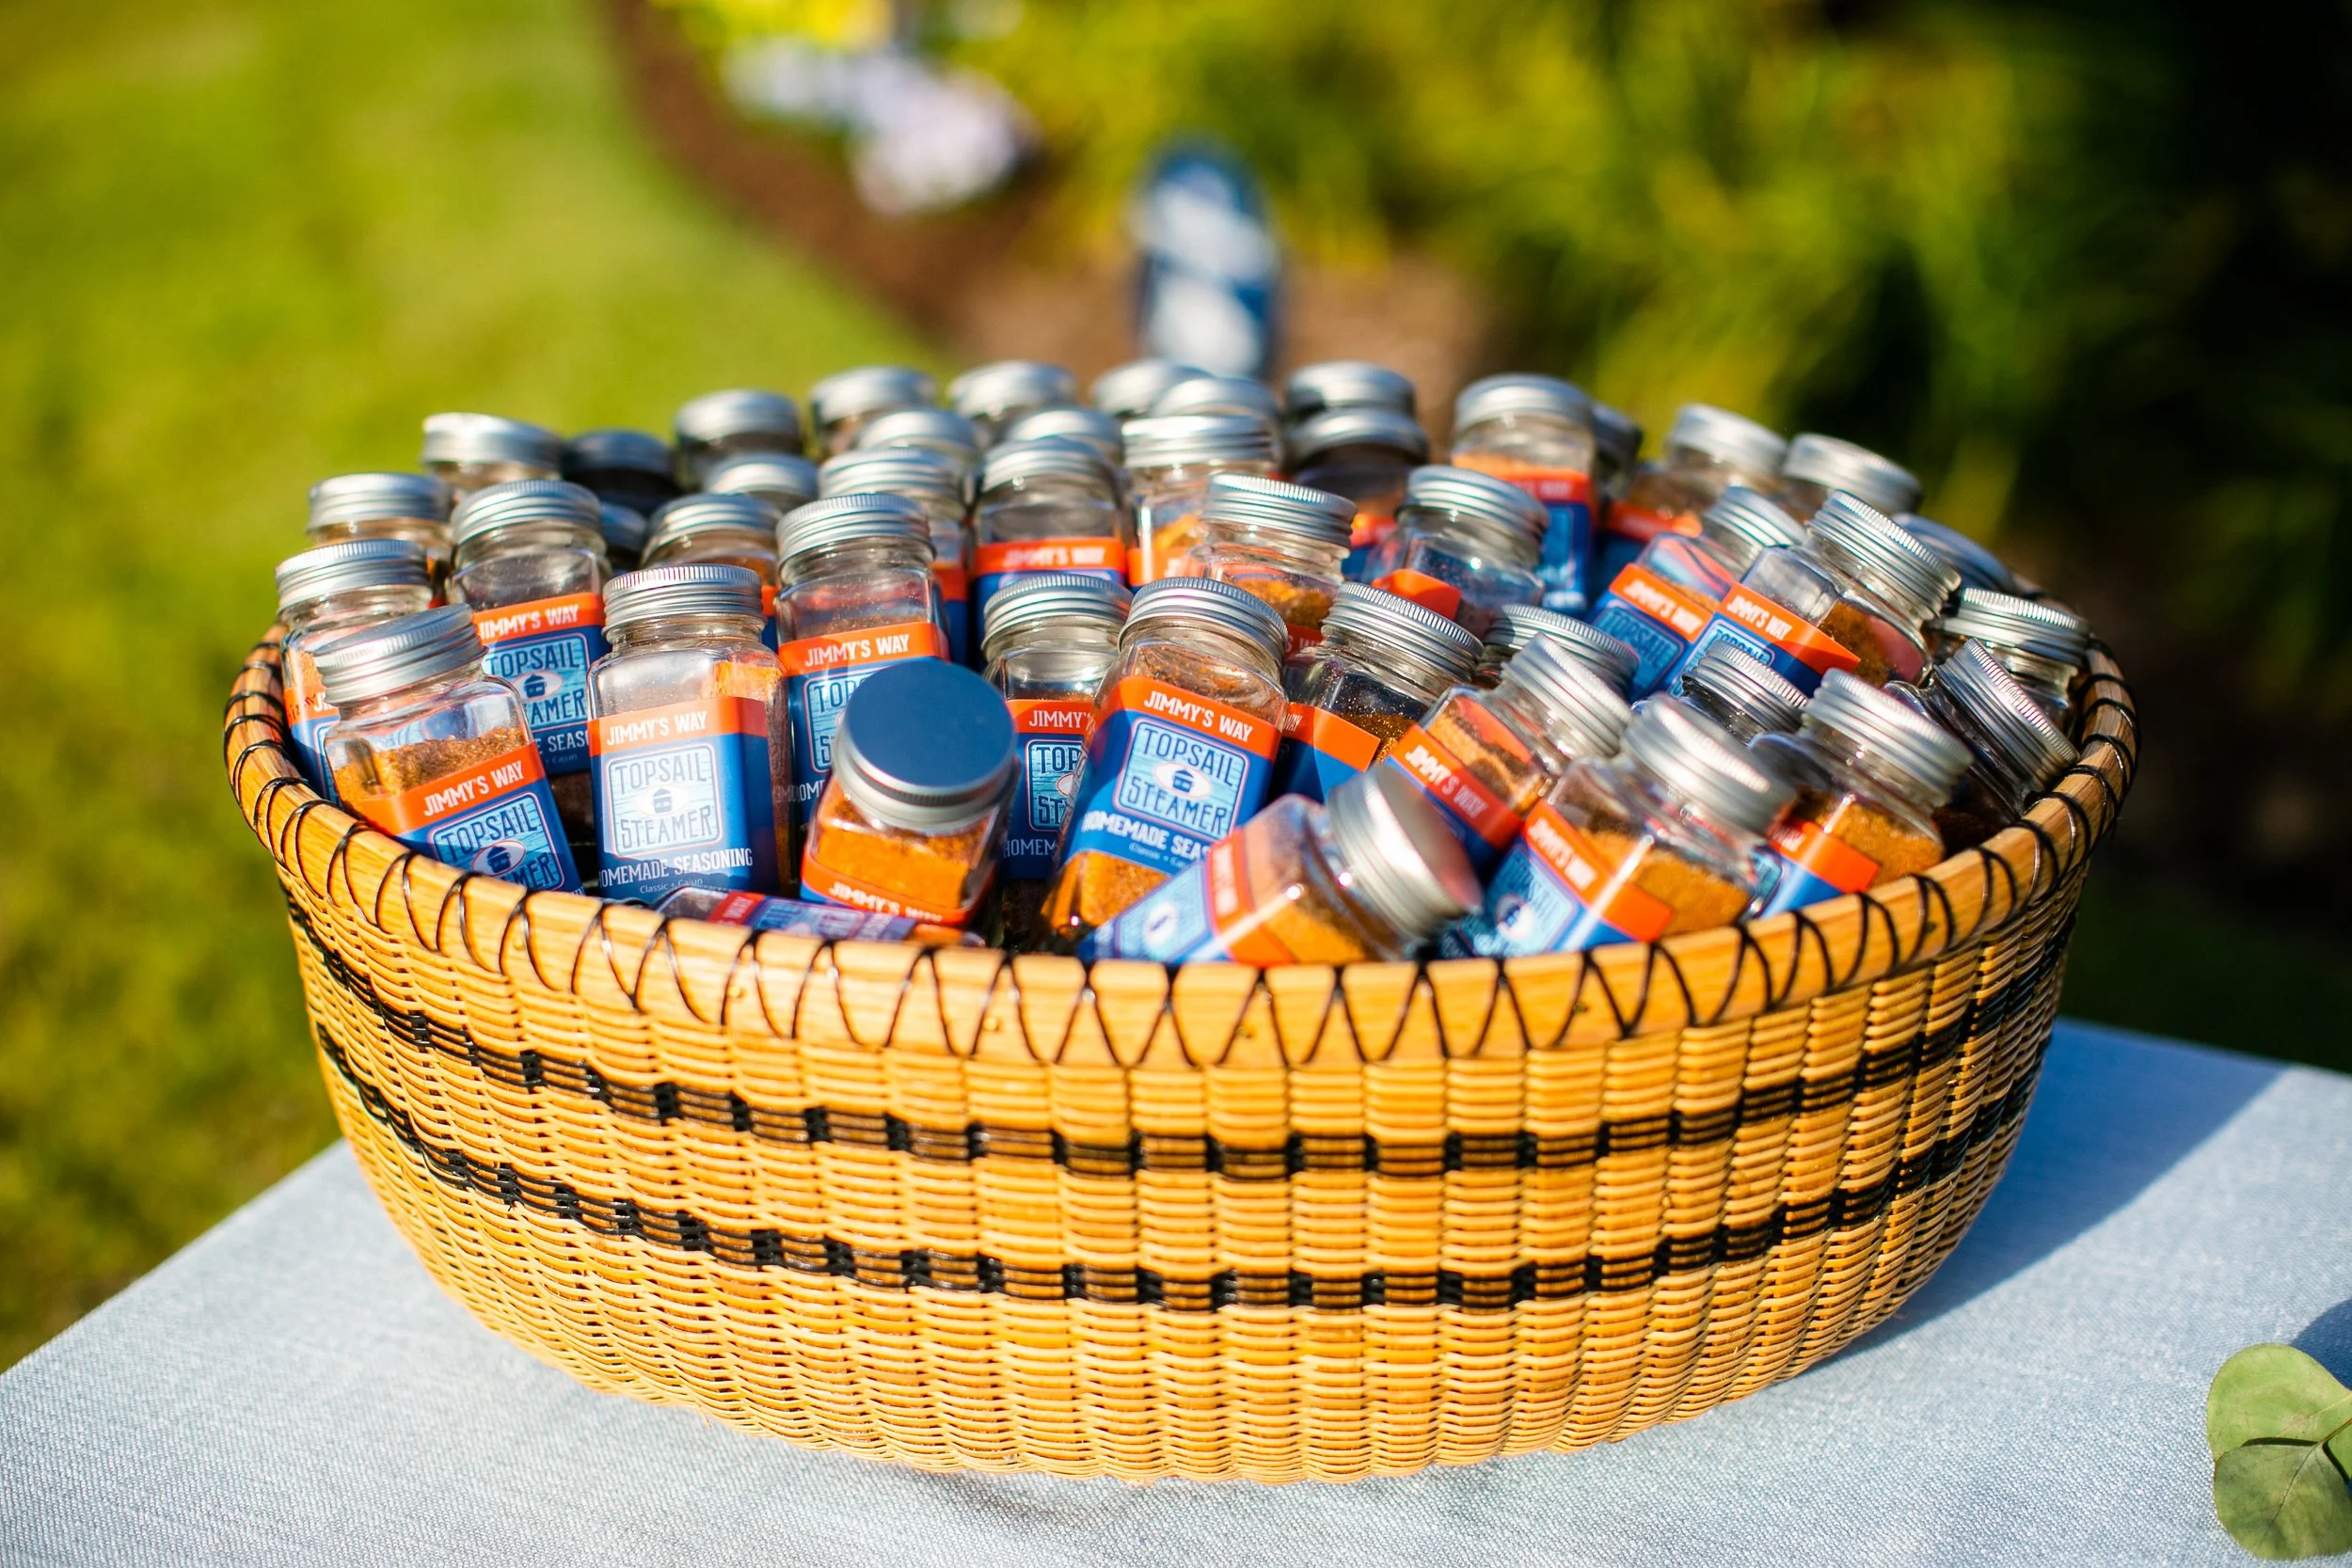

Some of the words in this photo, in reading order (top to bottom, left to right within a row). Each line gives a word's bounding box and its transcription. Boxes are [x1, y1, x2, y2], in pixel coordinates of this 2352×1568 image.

[545, 604, 580, 627] WAY
[485, 641, 580, 678] TOPSAIL
[804, 639, 871, 667] JIMMY'S
[875, 634, 910, 656] WAY
[524, 689, 586, 725] AMER
[1028, 710, 1089, 728] JIMMY'
[1144, 690, 1215, 728] JIMMY'S
[1219, 715, 1253, 742] WAY
[607, 718, 669, 746] JIMMY'S
[675, 711, 707, 734] WAY
[614, 752, 707, 795] TOPSAIL
[1143, 727, 1235, 787] TOPSAIL
[423, 775, 490, 817] JIMMY'S
[490, 760, 524, 788] WAY
[1127, 775, 1228, 836] STEAMER
[440, 802, 538, 863] TOPSAIL
[620, 805, 714, 850] STEAMER
[673, 847, 753, 876] SEASONING
[640, 882, 667, 895] Classic
